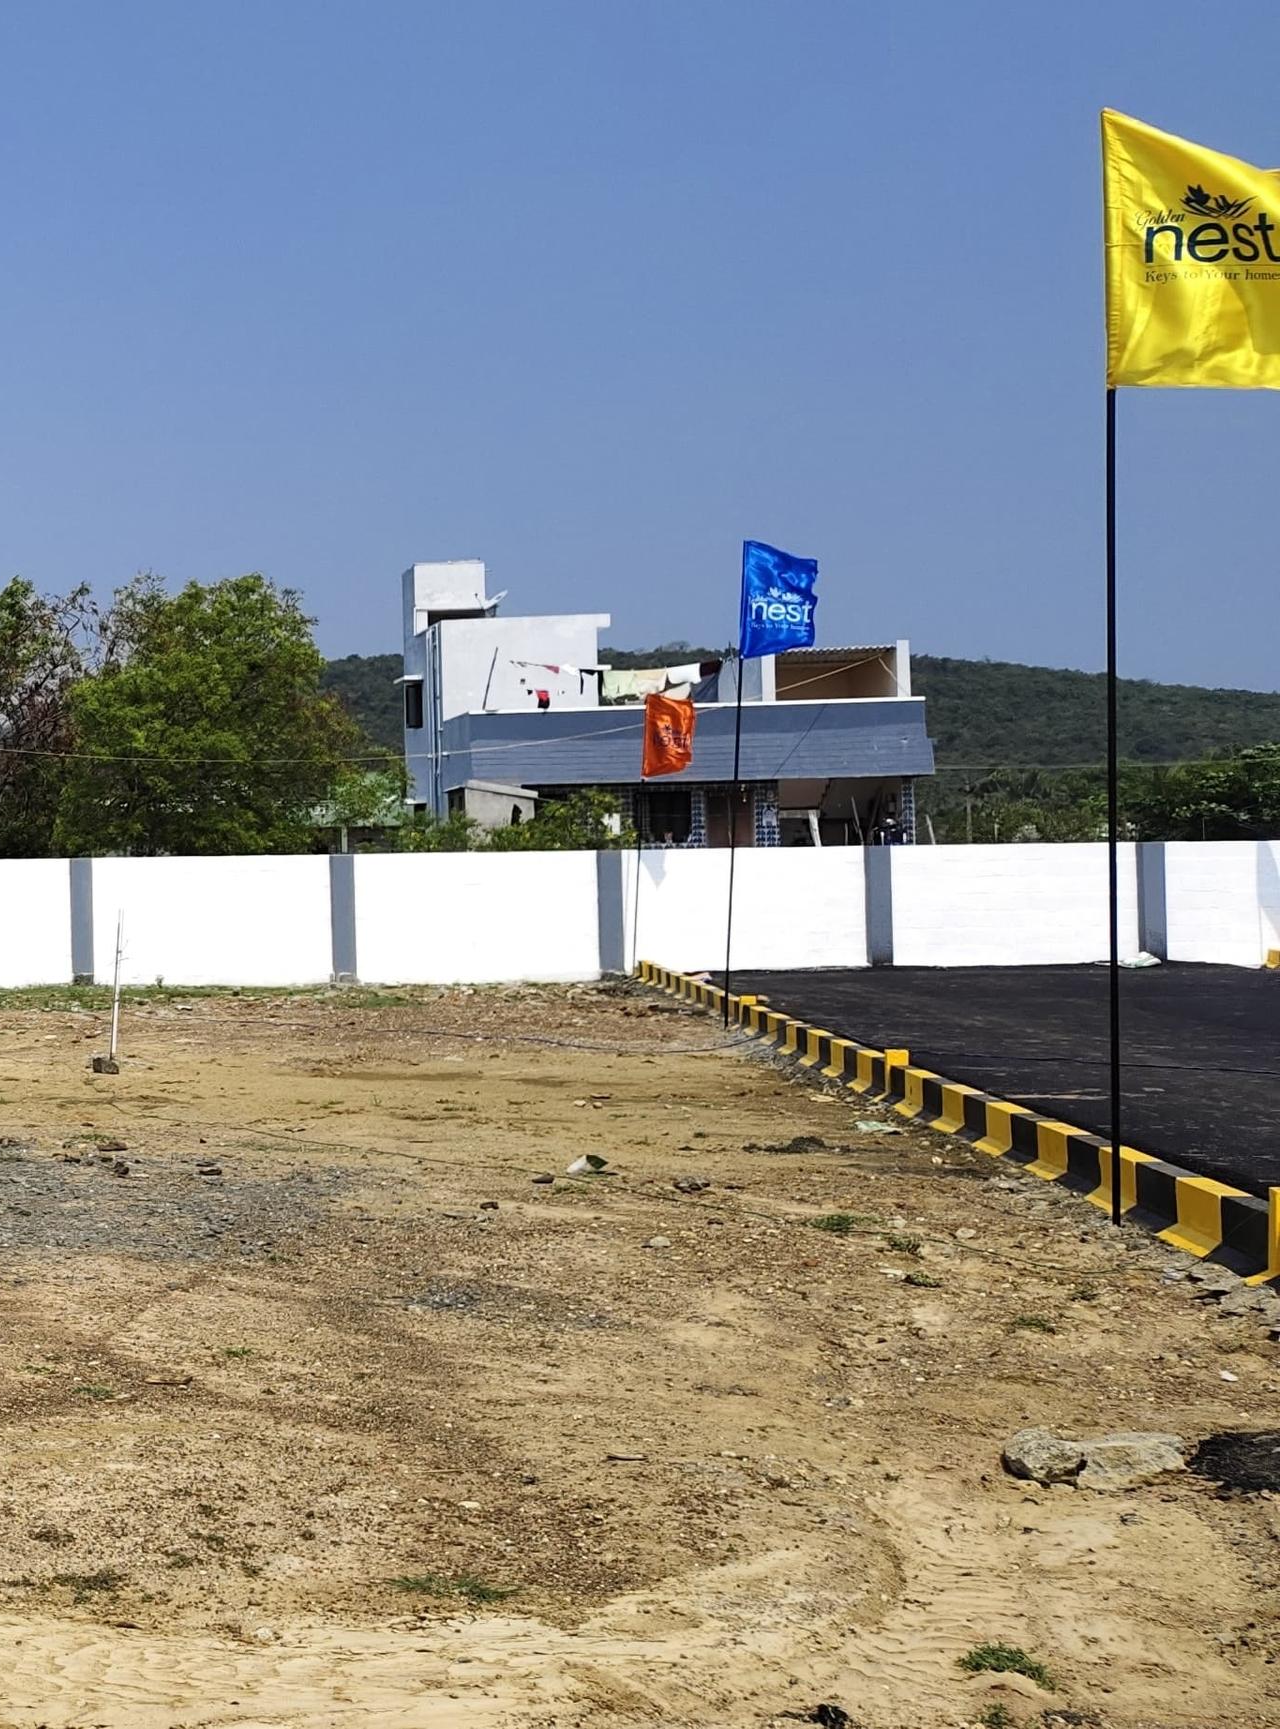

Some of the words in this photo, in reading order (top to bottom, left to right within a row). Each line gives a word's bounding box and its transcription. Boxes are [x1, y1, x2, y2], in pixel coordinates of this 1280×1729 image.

[1135, 209, 1185, 231] Golden
[1145, 212, 1280, 264] nest
[1145, 270, 1178, 284] Keys
[1205, 269, 1240, 281] Your
[751, 600, 812, 623] nest
